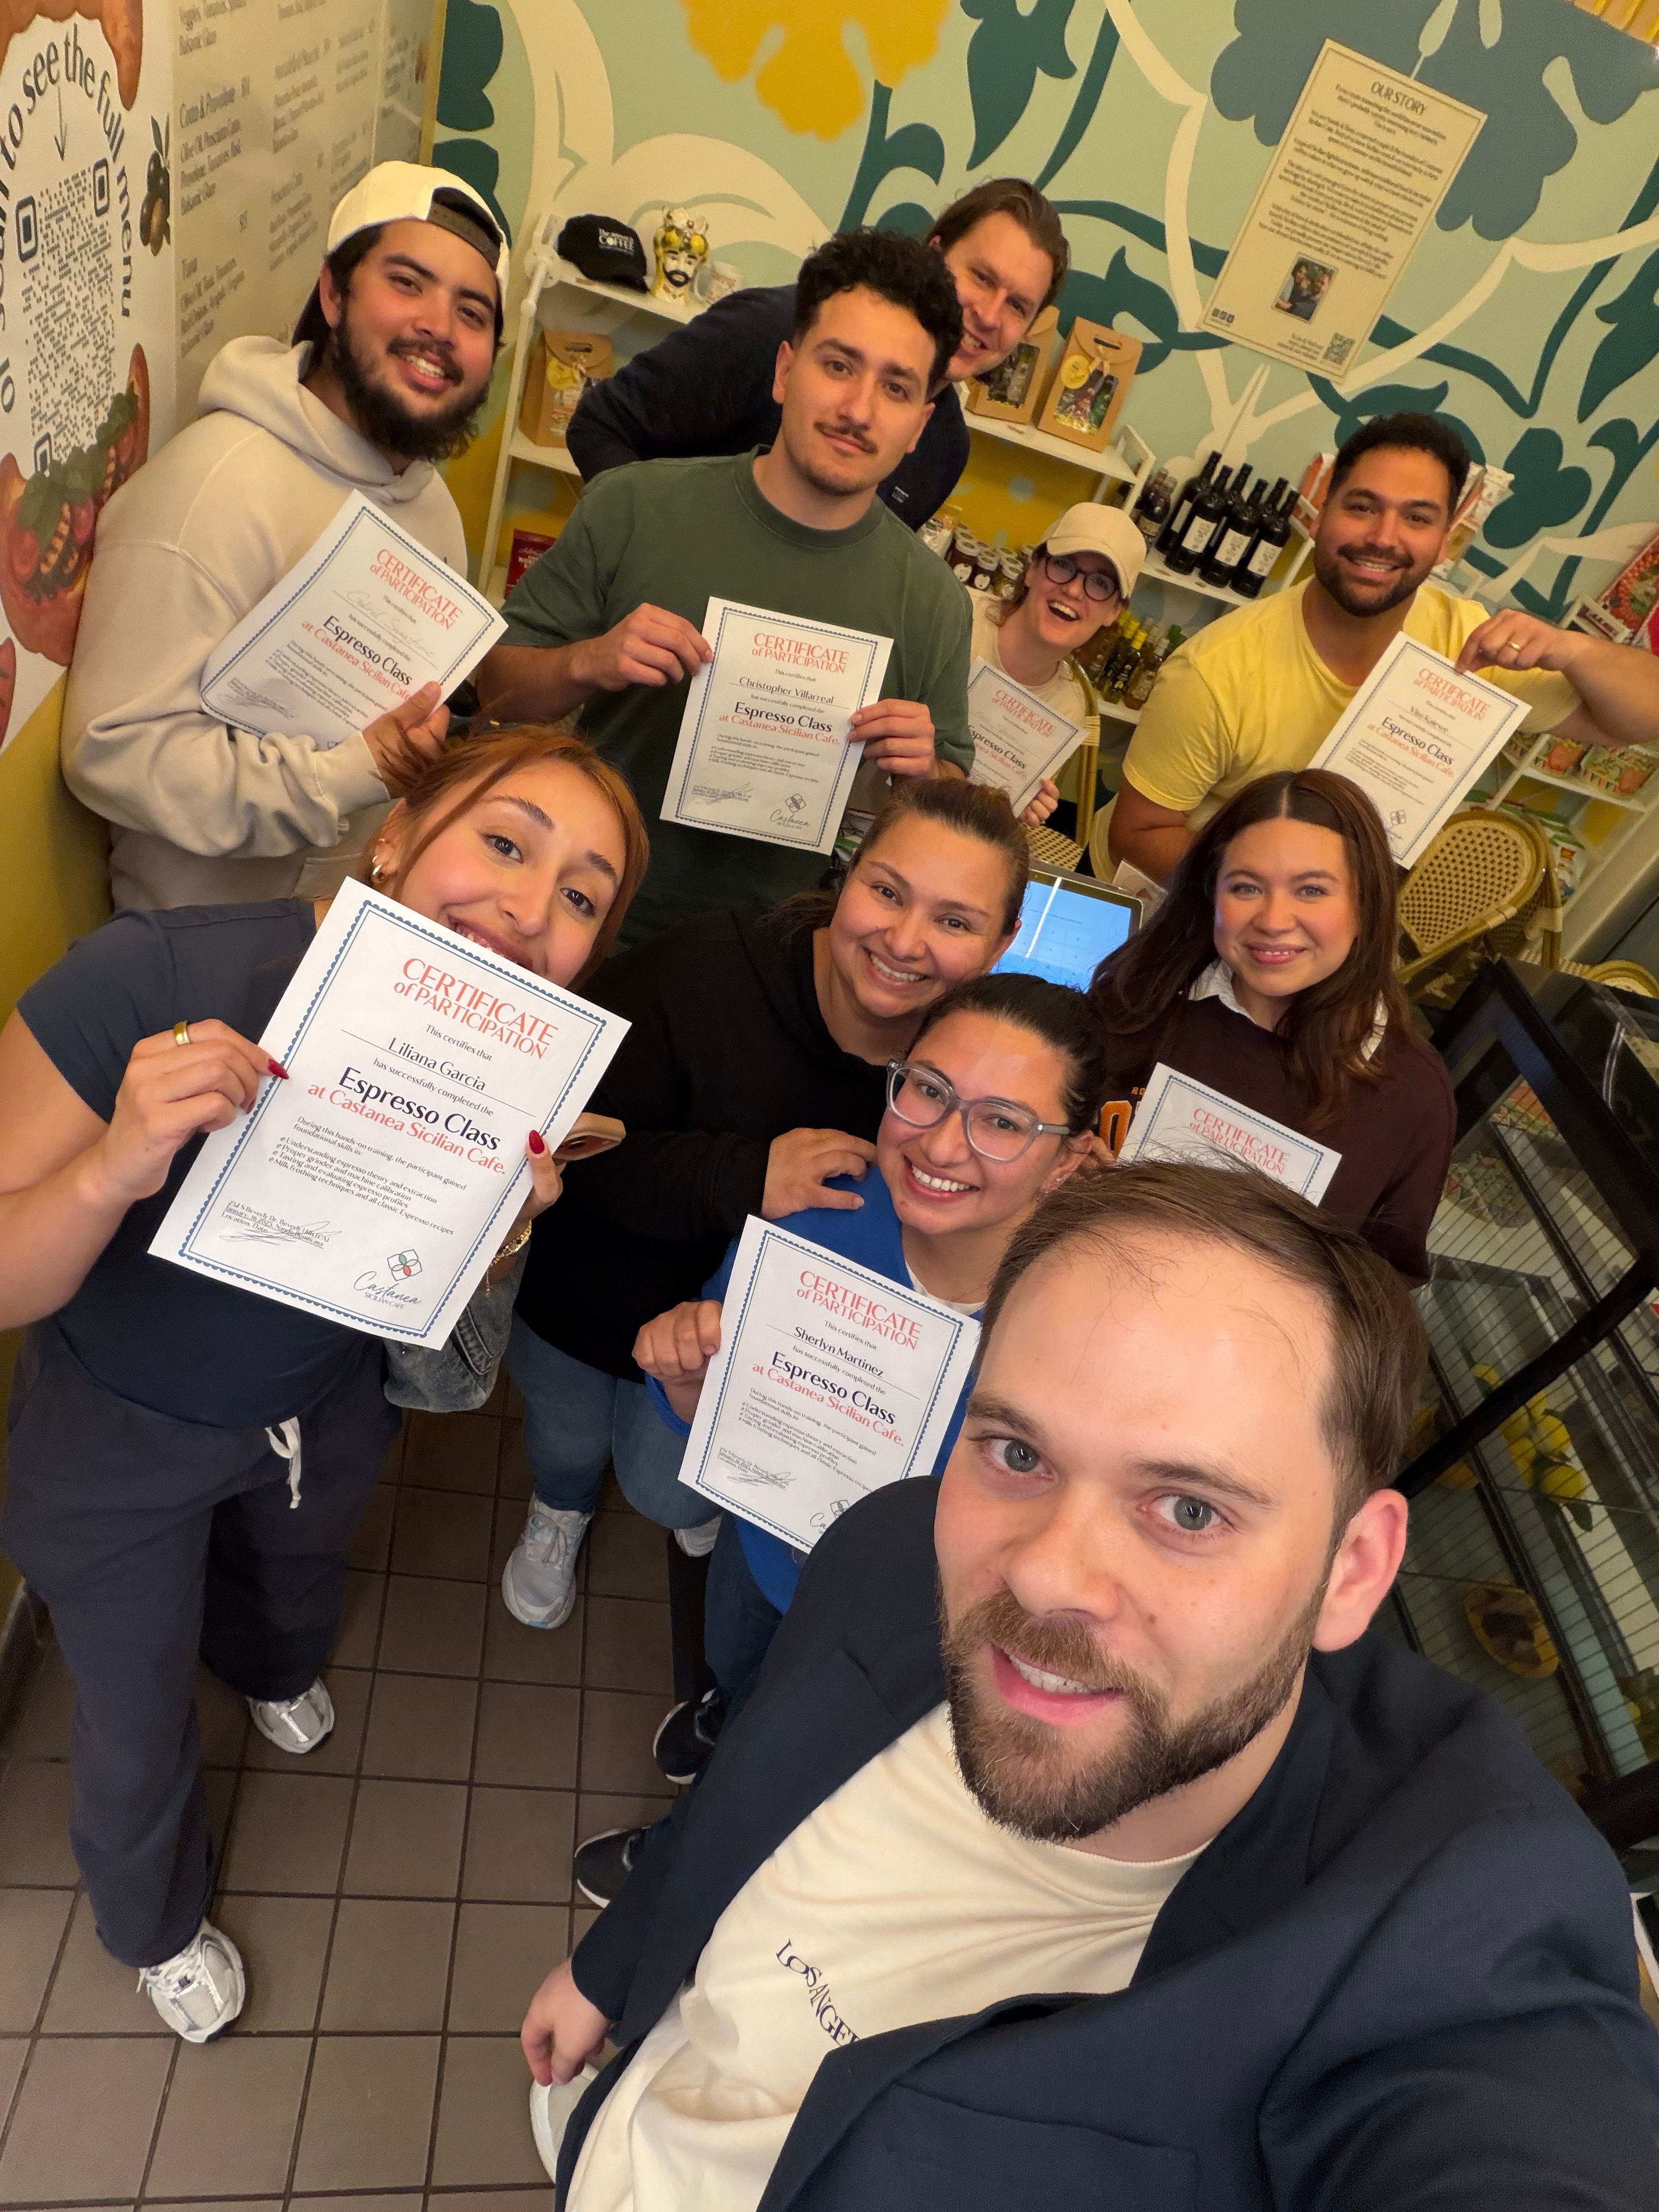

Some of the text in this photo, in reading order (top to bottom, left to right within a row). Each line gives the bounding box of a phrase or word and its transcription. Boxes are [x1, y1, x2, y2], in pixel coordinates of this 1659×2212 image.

[1370, 81, 1394, 101] OUR
[1392, 91, 1426, 116] STORY
[22, 42, 60, 115] see
[64, 23, 95, 98] the
[96, 70, 125, 163] full
[117, 165, 132, 317] menu
[370, 564, 381, 575] of
[380, 569, 454, 630] PARTICIPATION
[377, 548, 463, 623] CERTIFICATE
[301, 621, 314, 633] at
[314, 628, 359, 666] Castanea
[359, 661, 391, 689] Sicilian
[323, 615, 381, 664] Espresso
[382, 657, 412, 685] Class
[751, 647, 846, 675] of PARTICIPATION
[754, 633, 849, 665] CERTIFICATE
[735, 702, 833, 732] Espresso Class
[739, 676, 834, 704] Christopher Villarreal
[1419, 668, 1491, 715] CERTIFICATE
[731, 714, 777, 732] Castanea
[778, 724, 813, 740] Sicilian
[1381, 716, 1426, 749] Espresso
[1427, 744, 1454, 765] Class
[1004, 750, 1027, 769] Class
[394, 982, 547, 1059] of PARTICIPATION
[403, 958, 558, 1046] CERTIFICATE
[388, 1037, 486, 1091] Liliana Garcia
[426, 1024, 492, 1061] This certifies that
[338, 1067, 501, 1150] Espresso Class
[373, 1058, 494, 1116] has successfully completed the
[293, 1123, 337, 1145] foundational
[337, 1142, 353, 1153] skills
[297, 1116, 322, 1132] During
[322, 1127, 335, 1136] this
[335, 1131, 367, 1149] hands-on
[395, 1157, 407, 1166] the
[406, 1163, 443, 1181] participant
[442, 1178, 467, 1190] gained
[308, 1084, 505, 1174] at Castanea Sicilian Cafe.
[1194, 1108, 1291, 1166] CERTIFICATE
[1200, 1126, 1284, 1175] PARTICIPATION
[276, 1158, 288, 1169] Milk
[290, 1164, 318, 1181] frothing
[318, 1176, 354, 1195] techniques
[377, 1201, 398, 1213] classic
[399, 1209, 429, 1226] Espresso
[430, 1223, 454, 1235] recipes
[279, 1152, 408, 1208] Tasting and evaluating espresso profiles
[281, 1144, 412, 1201] Proper grinder and machine calibration
[286, 1137, 337, 1164] Understanding
[337, 1159, 366, 1174] espresso
[367, 1171, 389, 1184] theory
[403, 1186, 437, 1204] extraction
[353, 1271, 422, 1304] Castanea
[800, 1270, 923, 1340] CERTIFICATE
[797, 1289, 918, 1351] of PARTICIPATION
[825, 1321, 876, 1350] This certifies that
[793, 1345, 886, 1395] has successfully completed the
[794, 1326, 884, 1378] Sherlyn Martinez
[752, 1364, 904, 1447] at Castanea Sicilian Cafe.
[772, 1351, 895, 1424] Espresso Class
[776, 1938, 822, 1987] LOS
